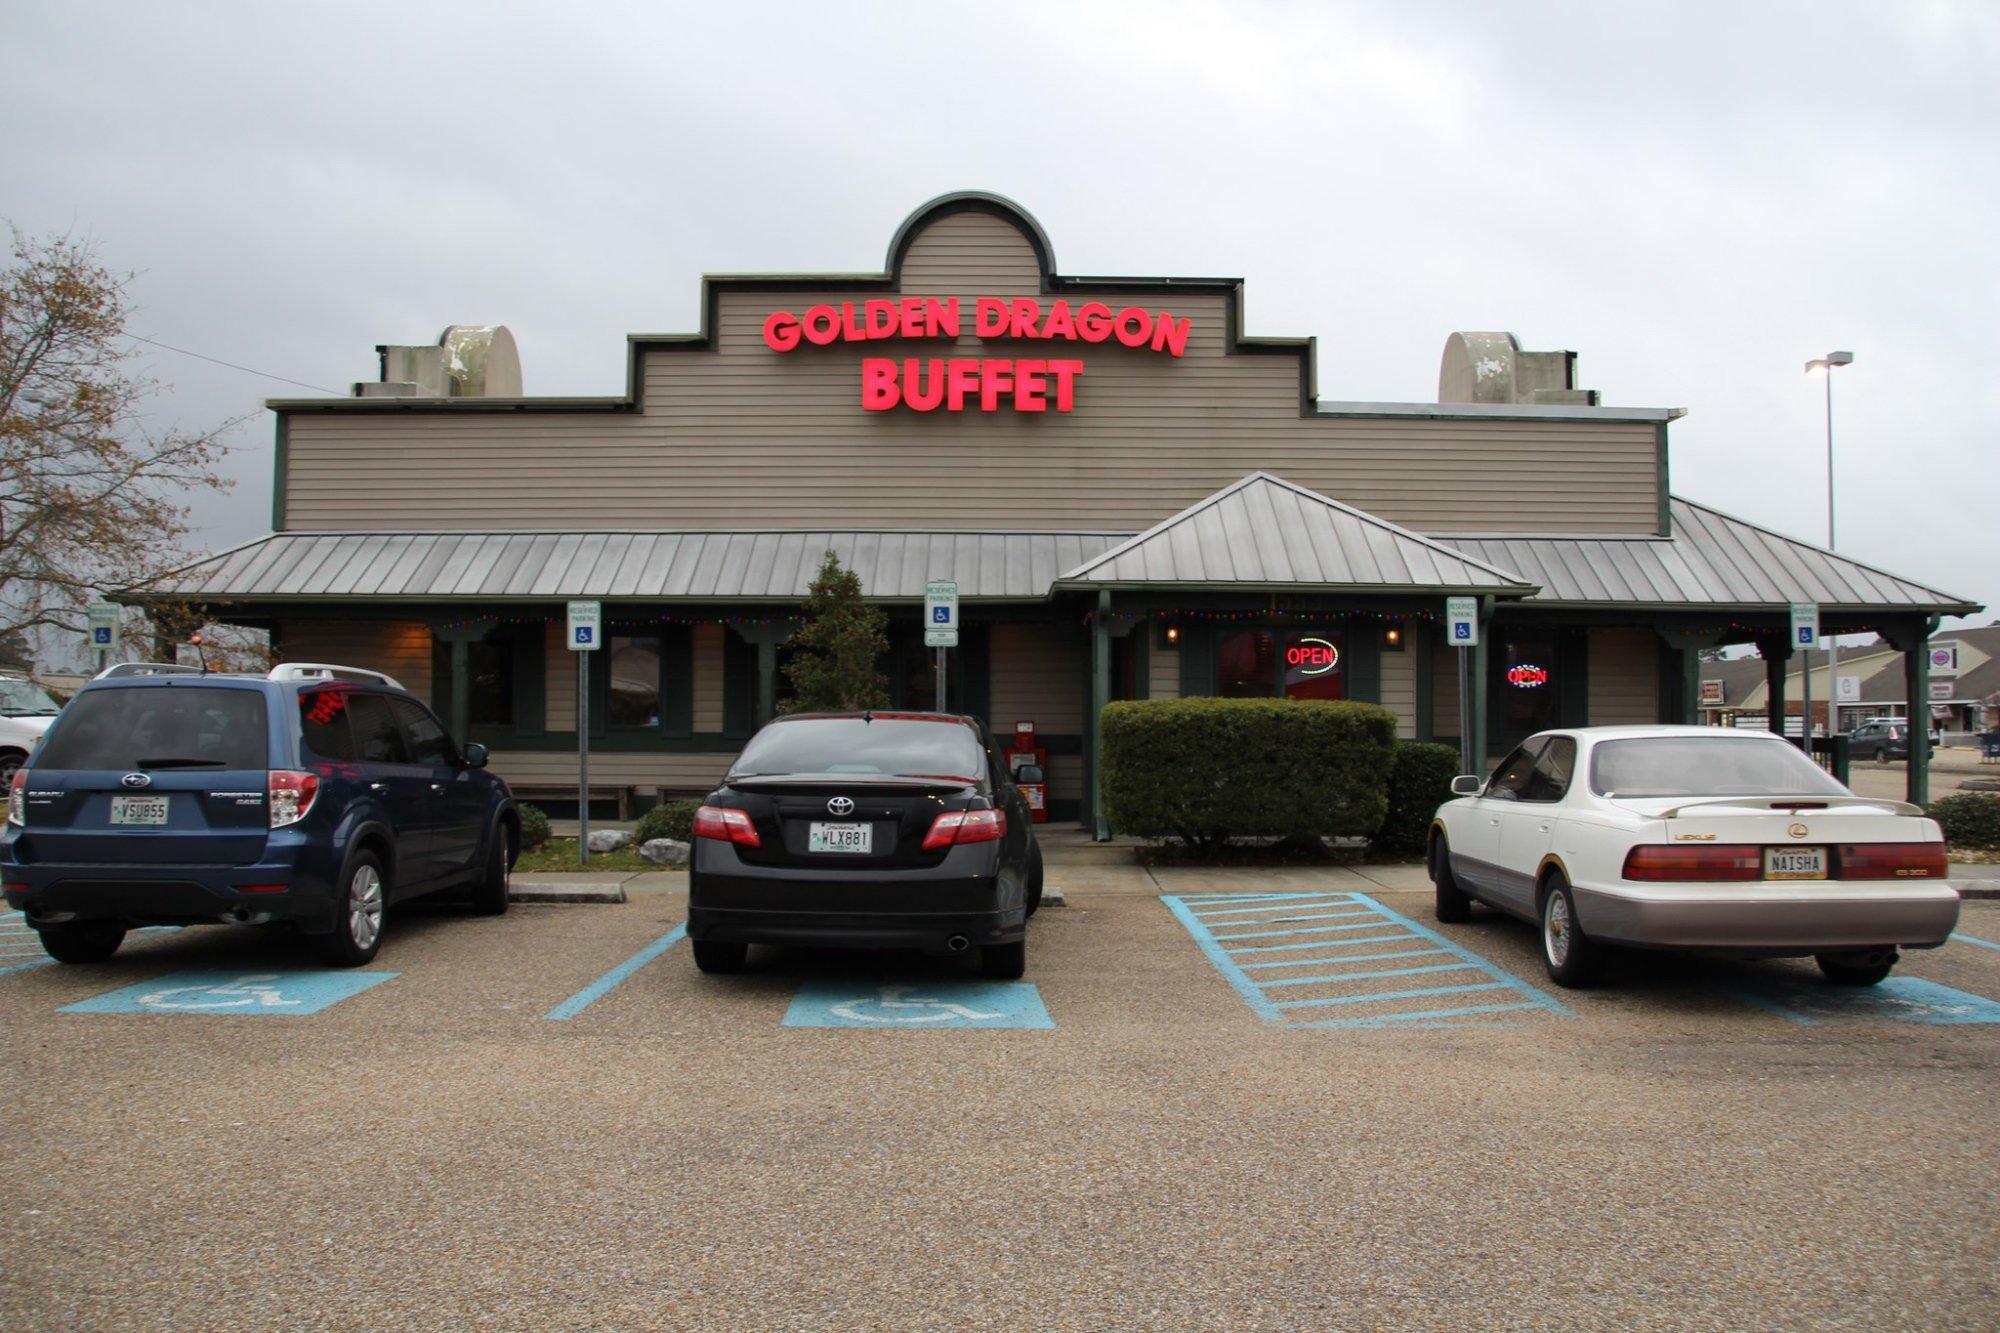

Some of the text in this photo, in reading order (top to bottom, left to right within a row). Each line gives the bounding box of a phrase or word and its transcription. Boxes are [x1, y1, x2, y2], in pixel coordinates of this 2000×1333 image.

[762, 298, 1192, 359] GOLDEN DRAGON
[861, 358, 1084, 413] BUFFET
[1286, 647, 1335, 665] OPEN
[1507, 669, 1547, 684] OPEN
[122, 803, 165, 818] VSU855
[822, 831, 867, 846] WLX881
[1674, 833, 1717, 841] LEXUS
[1772, 856, 1820, 871] NAISHA
